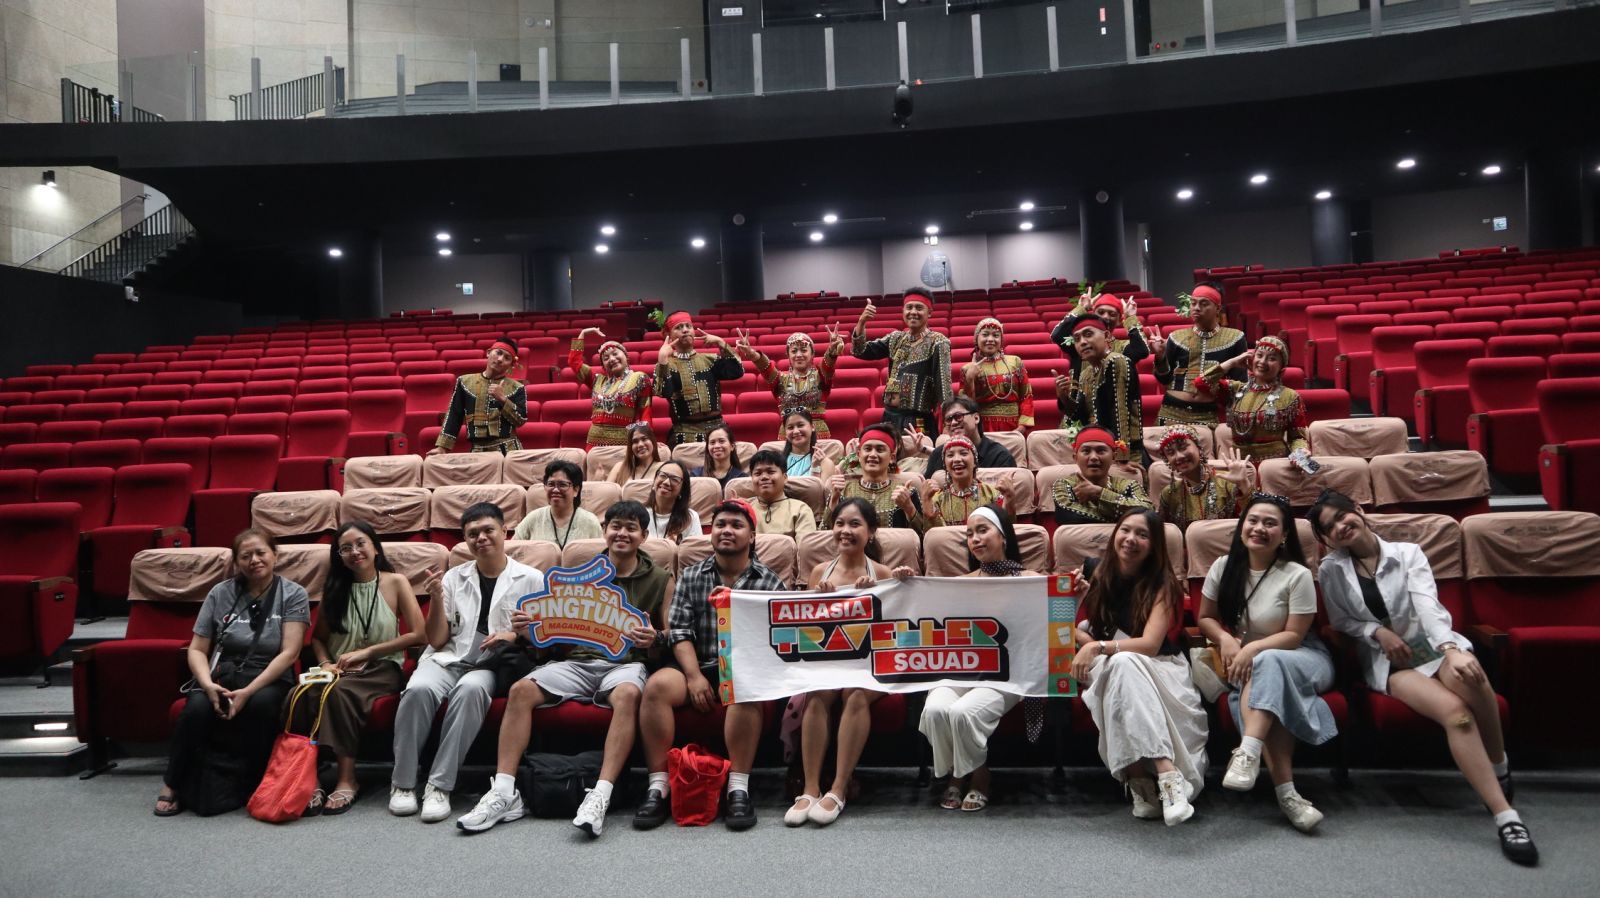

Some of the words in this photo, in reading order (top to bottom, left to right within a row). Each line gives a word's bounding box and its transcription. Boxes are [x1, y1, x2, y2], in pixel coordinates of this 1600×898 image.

[553, 585, 594, 598] TARA
[600, 590, 619, 607] SA
[526, 598, 639, 634] PINGTUNG
[778, 601, 867, 620] AIRASIA
[548, 623, 591, 632] MAGANDA
[593, 627, 614, 639] DITO
[771, 619, 1000, 654] TRAVELLER
[894, 651, 980, 672] SQUAD
